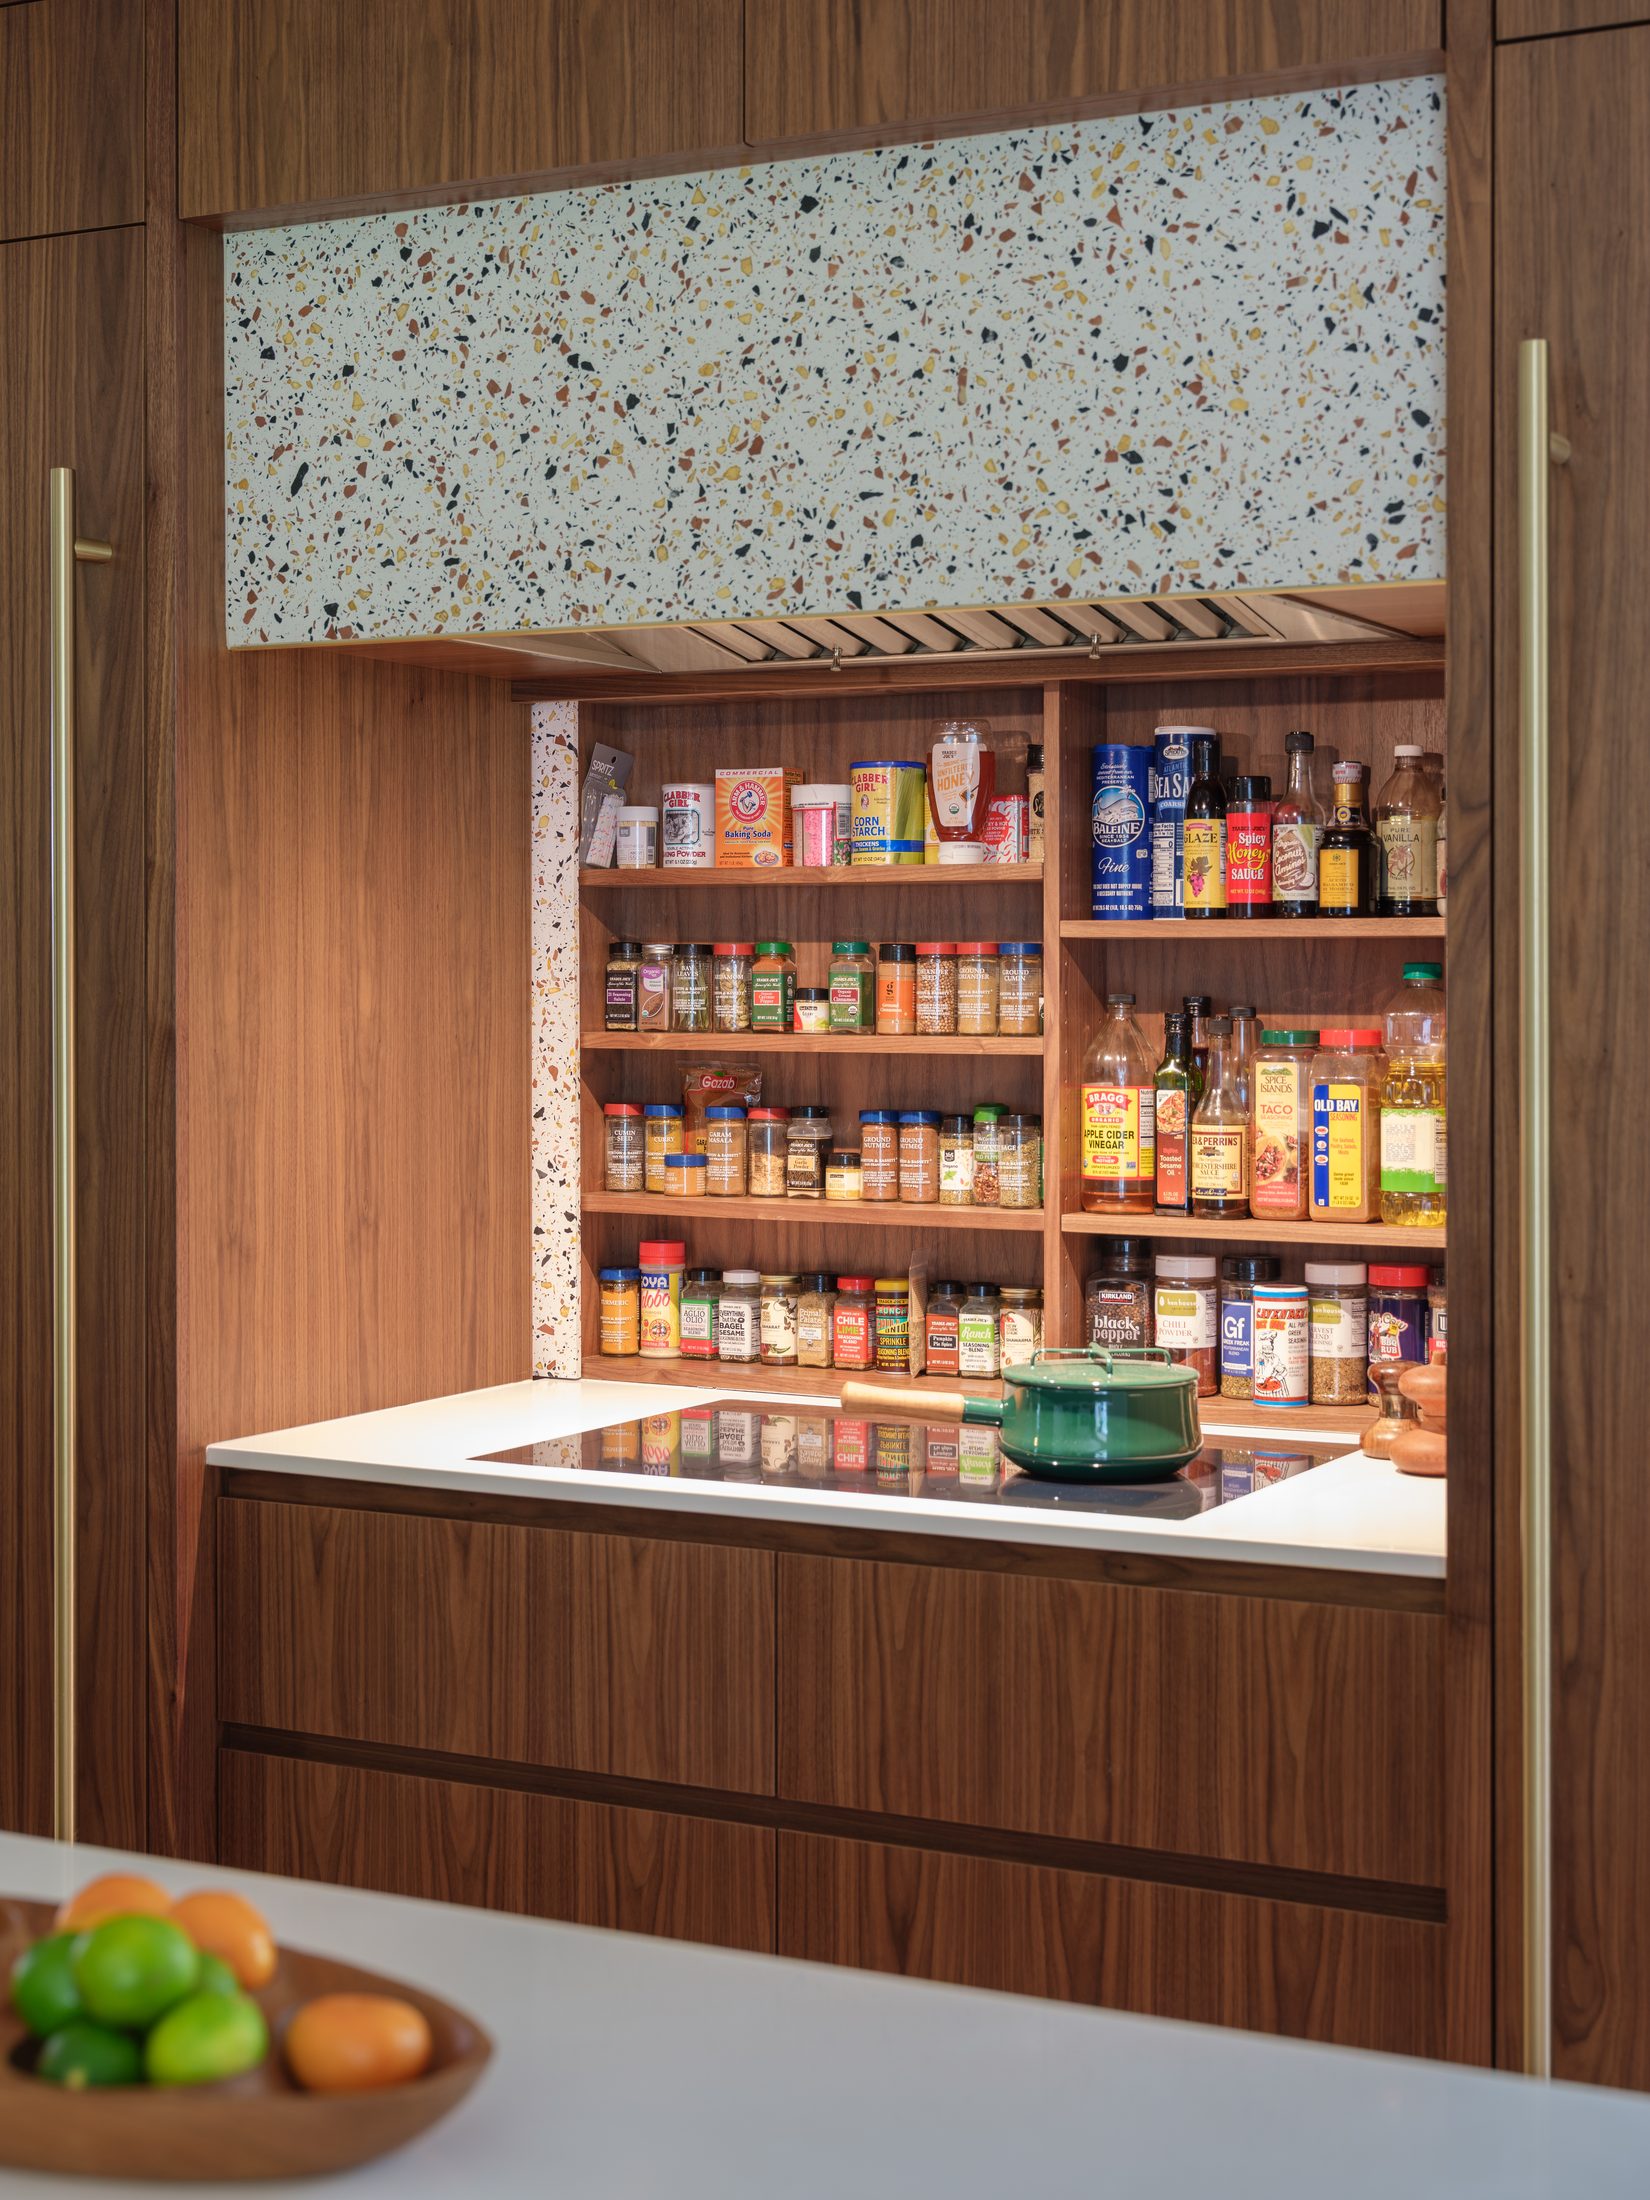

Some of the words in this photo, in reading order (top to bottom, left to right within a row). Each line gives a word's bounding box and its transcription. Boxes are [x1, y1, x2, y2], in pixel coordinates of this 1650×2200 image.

[591, 760, 615, 777] SPRITZ
[856, 783, 877, 793] GIRL
[1154, 774, 1170, 799] SEA
[745, 783, 766, 806] HAMMER
[854, 816, 879, 827] CORN
[852, 826, 886, 837] STARCH
[1093, 821, 1140, 834] BALEINE
[725, 831, 751, 839] Baking
[753, 830, 771, 838] Soda
[1184, 832, 1218, 843] GLAZE
[1238, 832, 1266, 846] Spicy
[1383, 833, 1420, 843] VANILLA
[1228, 842, 1269, 870] Honey
[1275, 849, 1304, 866] Coconut
[1098, 857, 1131, 875] Fine
[1275, 857, 1306, 876] Aminos
[1231, 868, 1264, 880] SAUCE
[702, 1075, 736, 1090] Gazab
[1265, 1076, 1287, 1085] SPICE
[1260, 1083, 1293, 1093] ISLANDS
[1089, 1092, 1124, 1104] BRAGG
[1260, 1104, 1293, 1115] TACO
[1314, 1099, 1334, 1112] OLD
[1336, 1100, 1357, 1112] BAY
[1330, 1112, 1358, 1121] SEASONING
[1084, 1129, 1104, 1139] APPLE
[1106, 1130, 1135, 1140] CIDER
[1089, 1139, 1124, 1149] VINEGAR
[1203, 1137, 1238, 1146] PERRINS
[719, 1310, 746, 1318] EVERYTHING
[719, 1322, 745, 1330] BAGEL
[836, 1316, 865, 1326] CHILE
[1094, 1314, 1140, 1331] black
[1382, 1312, 1408, 1331] Cow
[836, 1325, 858, 1335] LIME
[961, 1326, 992, 1340] Ranch
[1159, 1328, 1193, 1337] POWDER
[1224, 1316, 1246, 1339] Gf
[1093, 1327, 1141, 1343] pepper
[879, 1337, 906, 1346] SPRINKLE
[1381, 1338, 1397, 1346] BBQ
[1381, 1346, 1398, 1354] RUB
